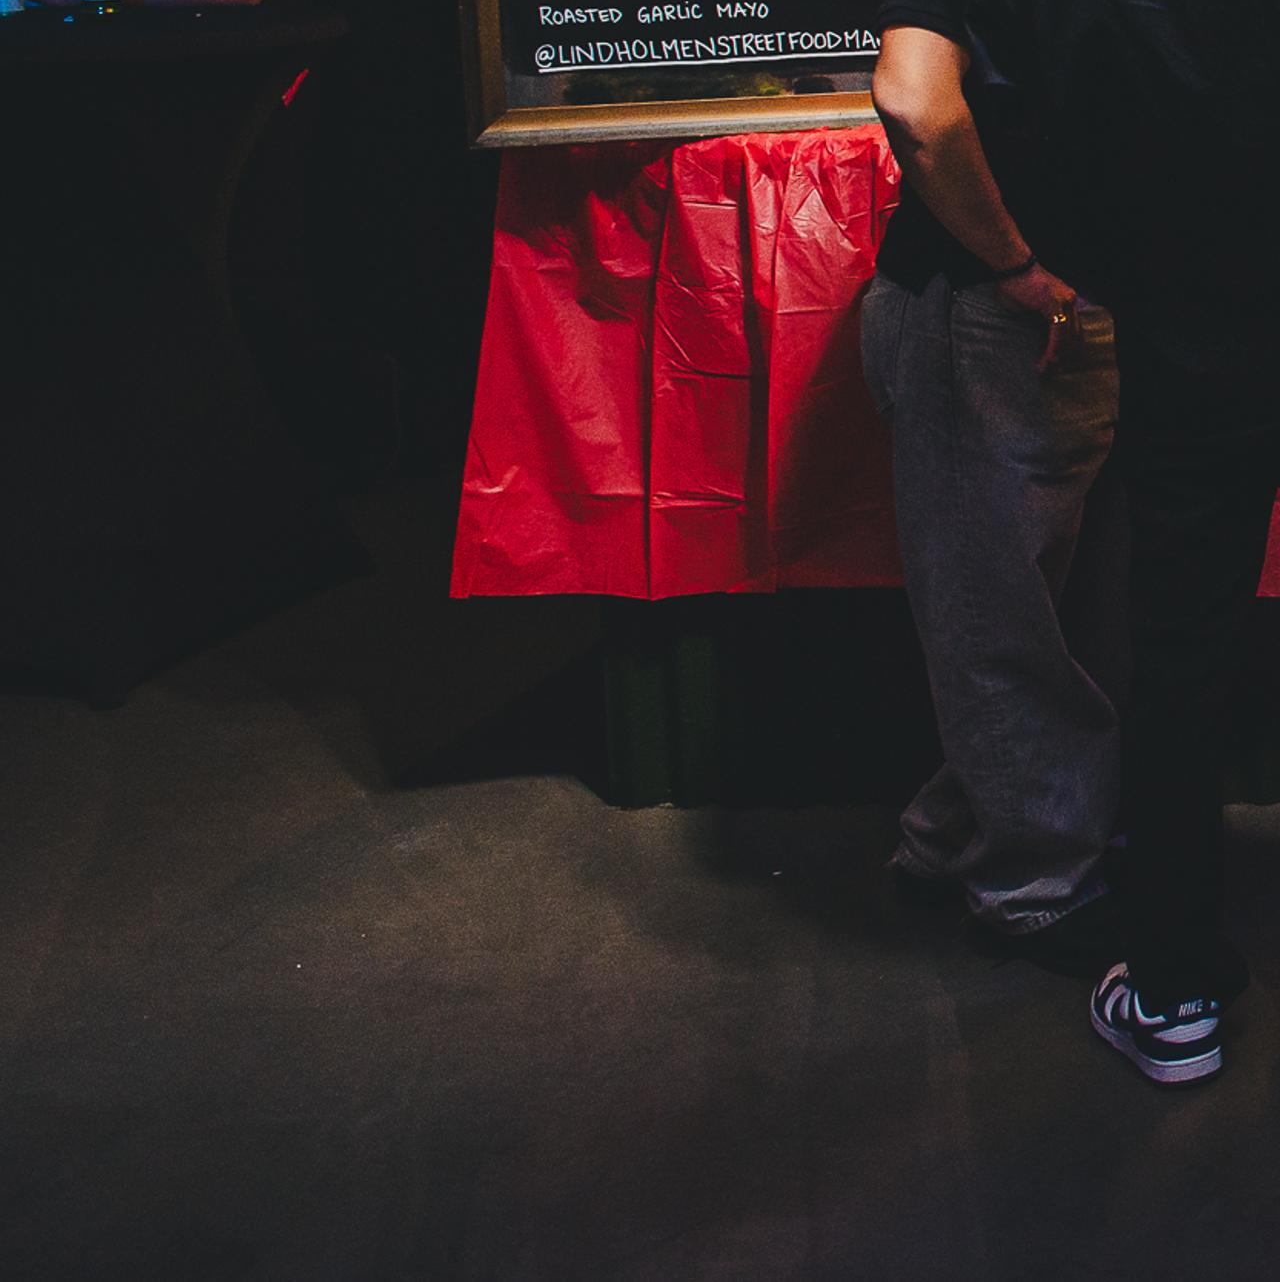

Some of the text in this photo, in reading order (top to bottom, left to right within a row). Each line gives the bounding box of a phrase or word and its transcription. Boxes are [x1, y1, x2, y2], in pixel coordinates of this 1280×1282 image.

[539, 5, 623, 26] ROASTED
[716, 1, 769, 19] MAYO
[1178, 999, 1204, 1017] NIKE
